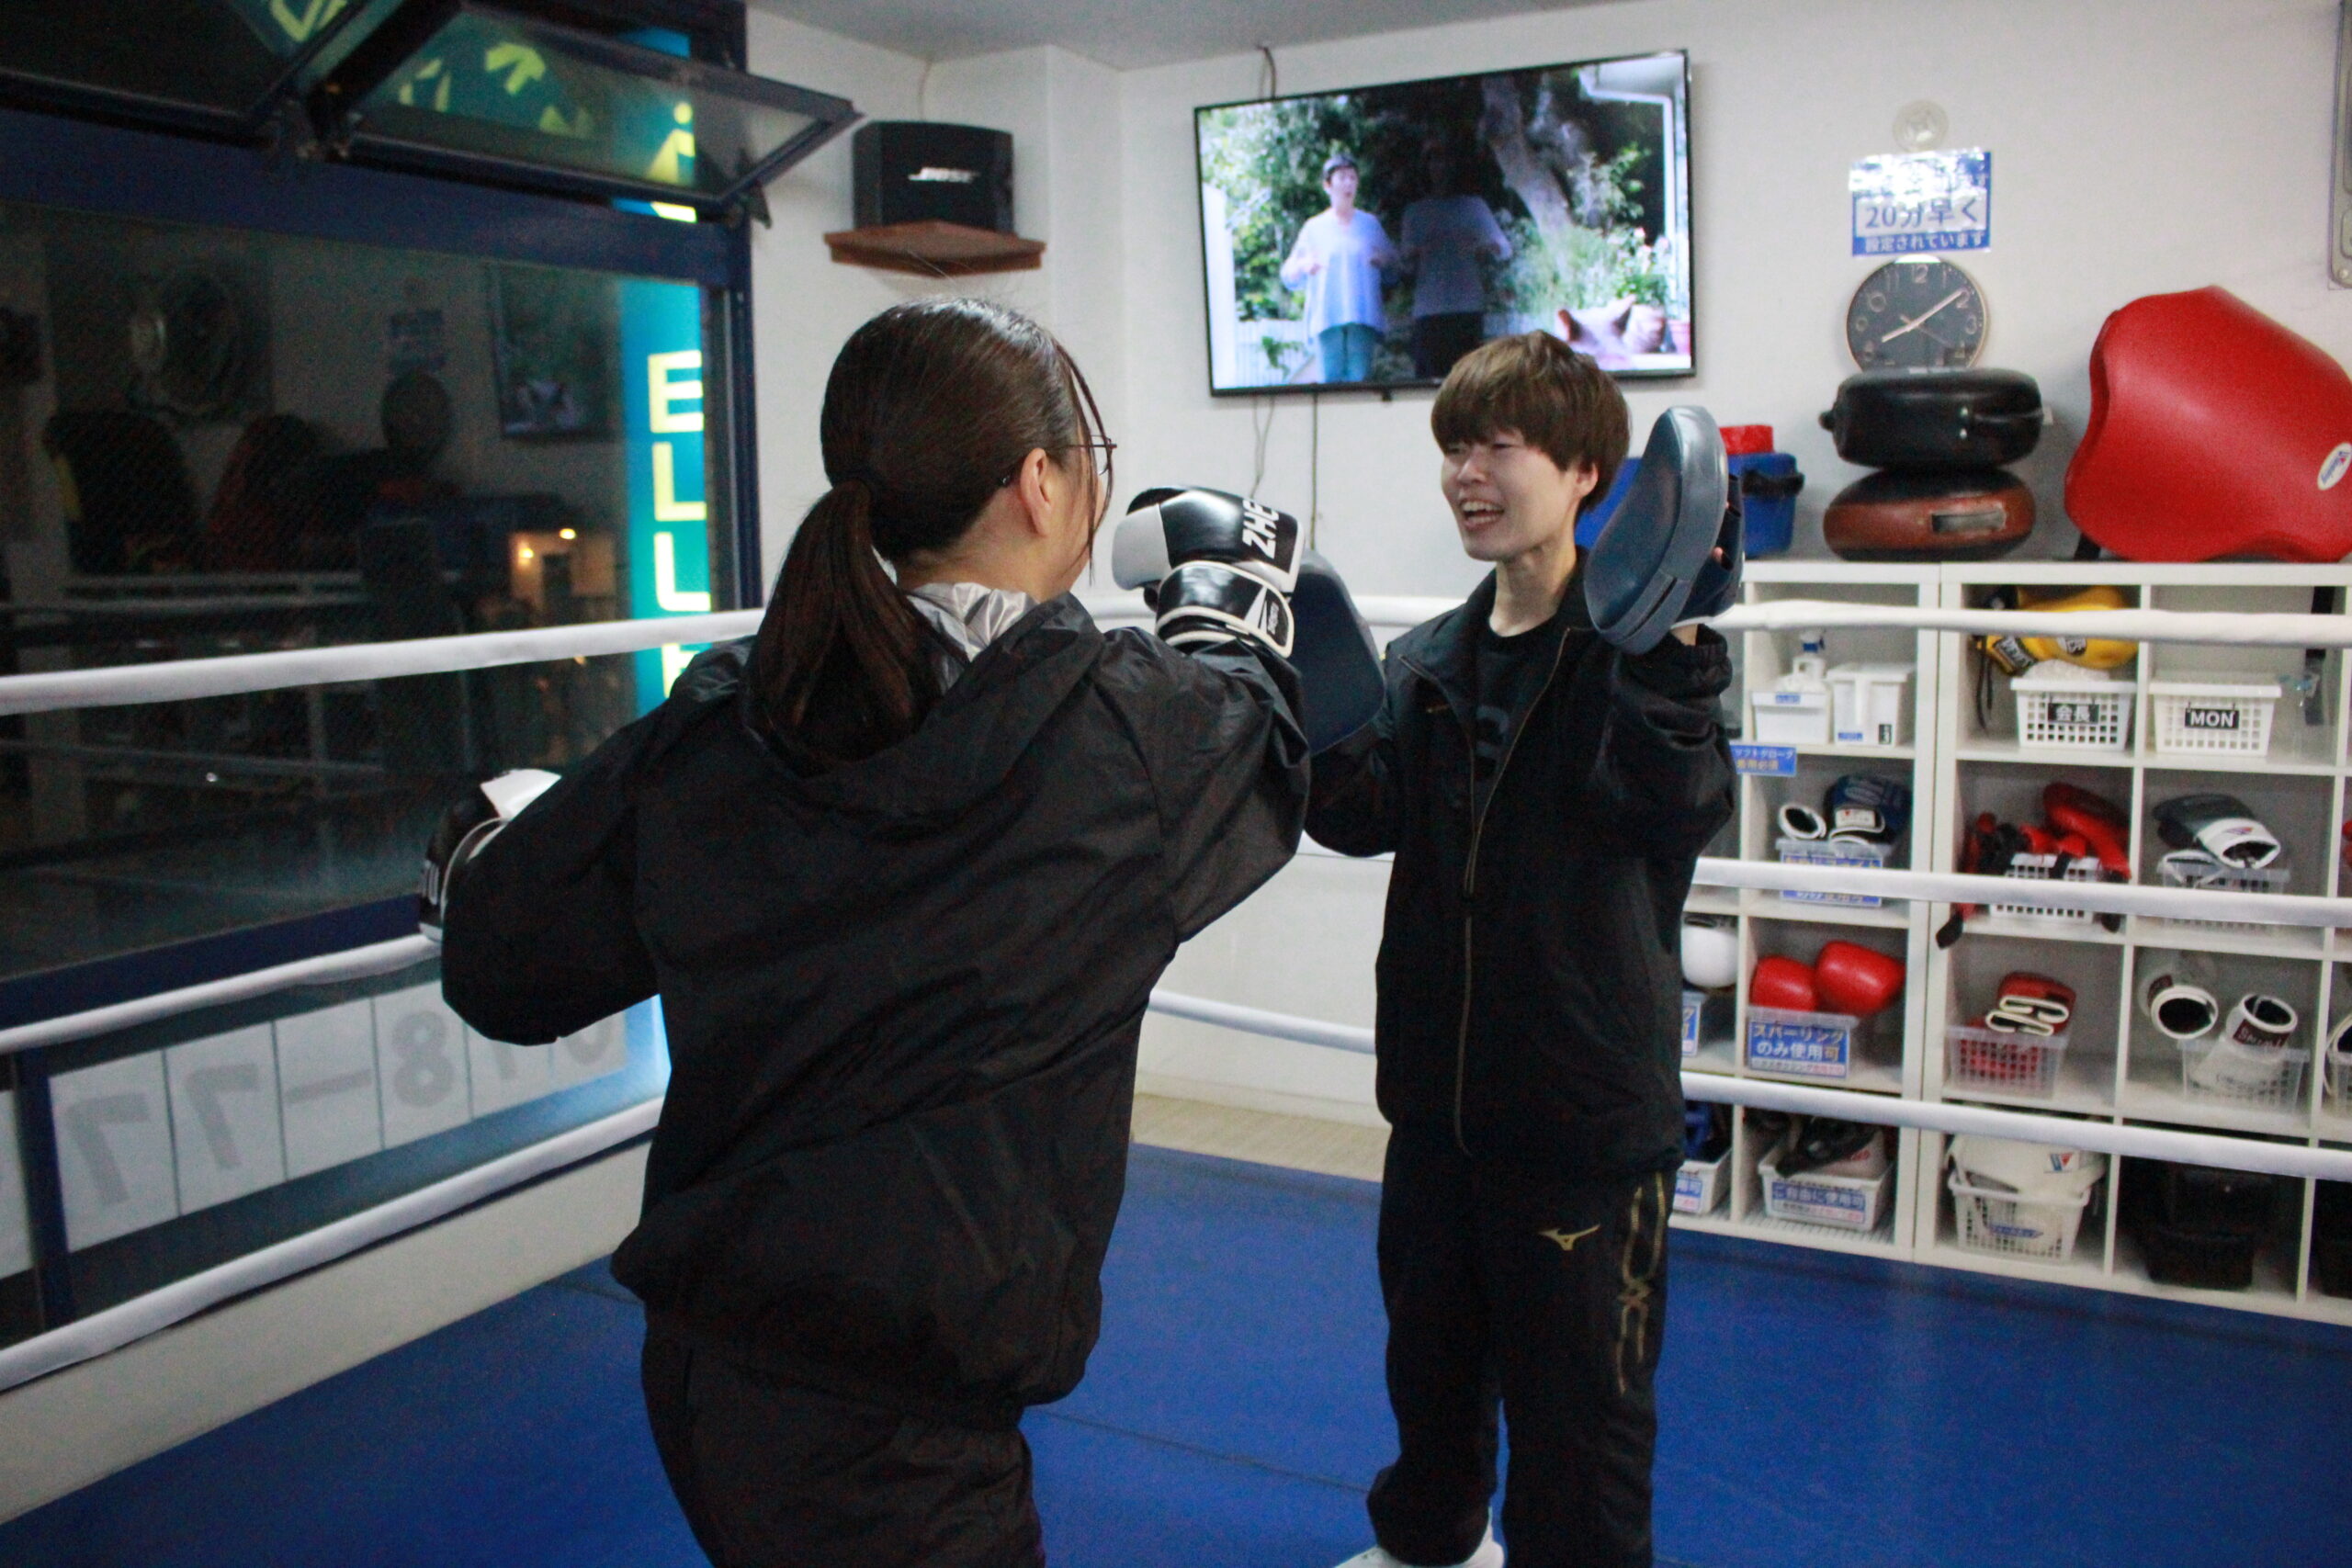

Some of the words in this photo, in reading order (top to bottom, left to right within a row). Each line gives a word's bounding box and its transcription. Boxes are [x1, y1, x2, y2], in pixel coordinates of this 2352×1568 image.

[2055, 704, 2091, 723] 会長
[2189, 710, 2234, 728] MON
[1753, 1024, 1844, 1044] スパーリング
[1756, 1041, 1840, 1062] のみ使用可
